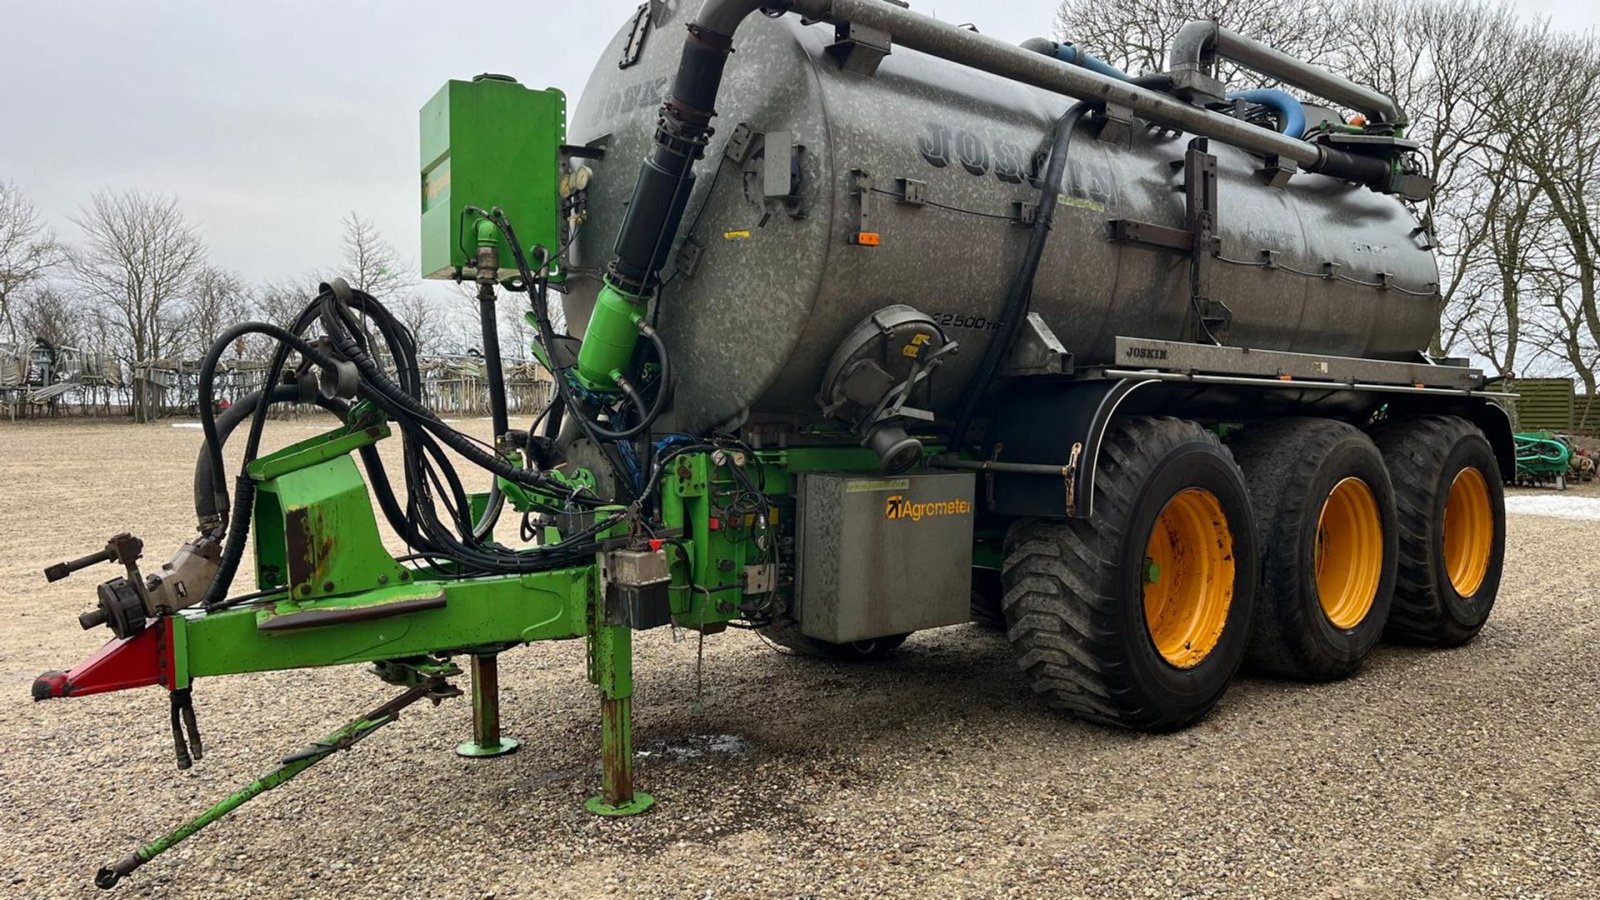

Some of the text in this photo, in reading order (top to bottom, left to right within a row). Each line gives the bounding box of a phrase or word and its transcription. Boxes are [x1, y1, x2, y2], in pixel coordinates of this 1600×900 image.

[592, 77, 671, 126] JOSK
[1126, 347, 1168, 360] JOSKIN
[903, 498, 970, 520] Agrometer
